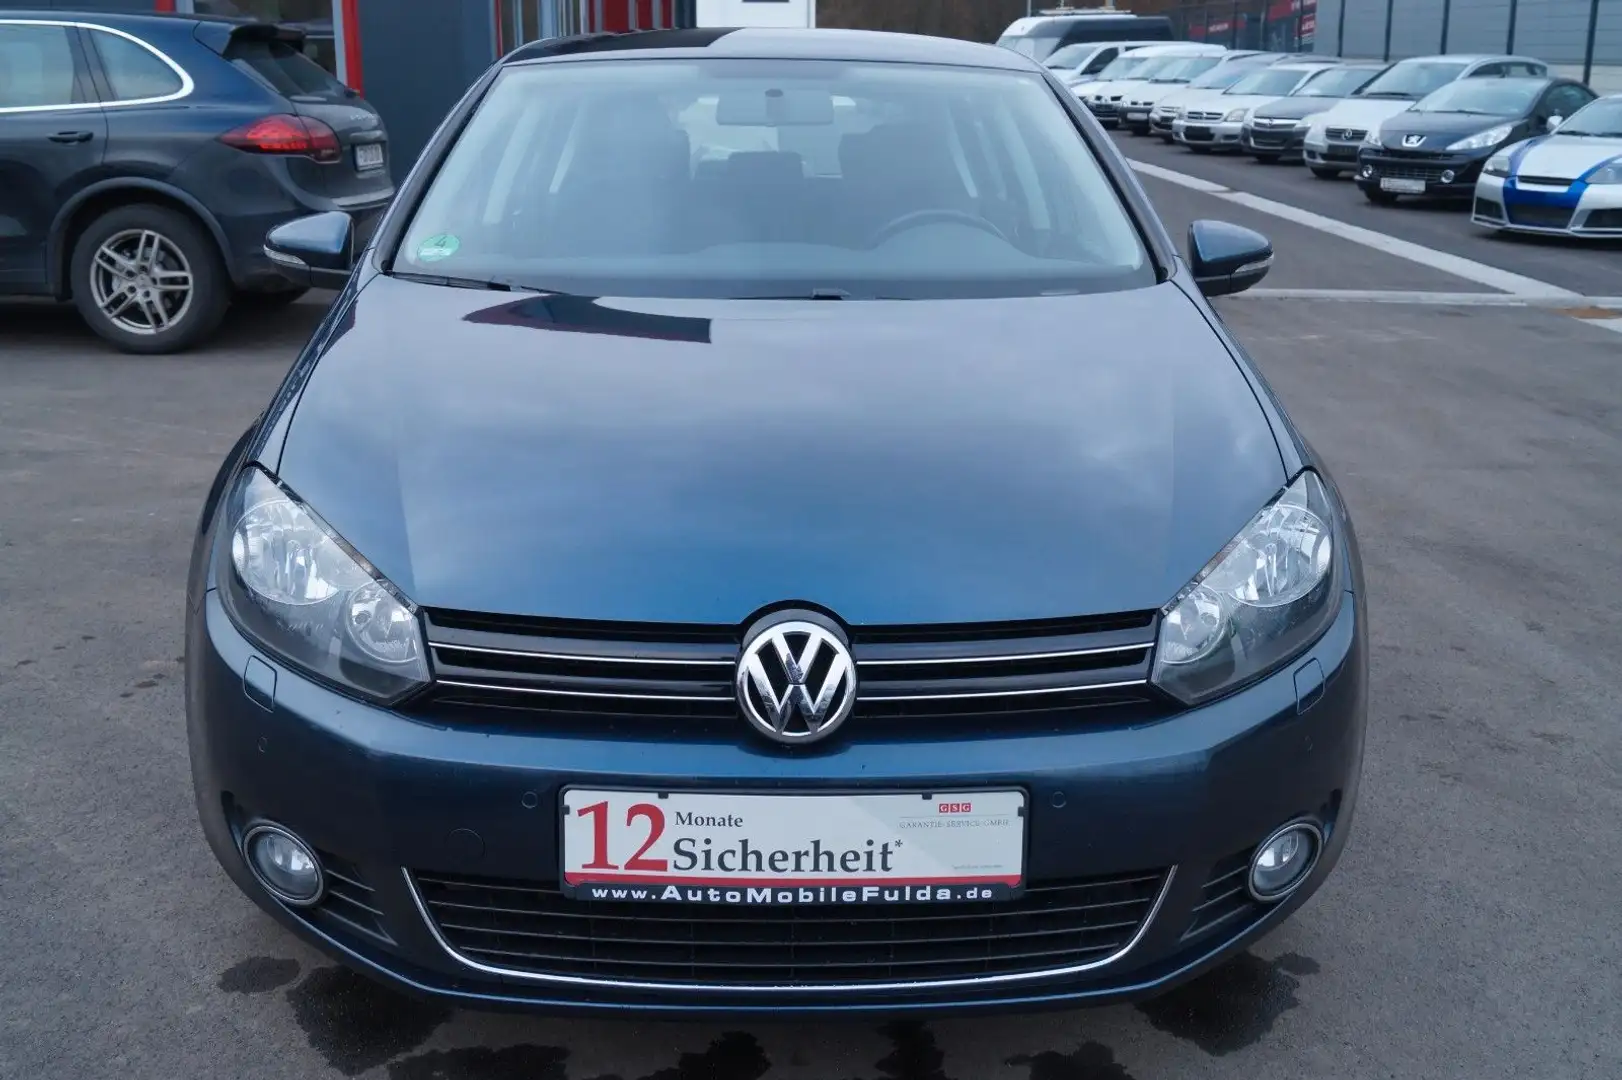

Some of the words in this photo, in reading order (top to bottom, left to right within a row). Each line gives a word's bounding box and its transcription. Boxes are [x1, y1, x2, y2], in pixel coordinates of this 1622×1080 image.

[434, 235, 447, 248] 4
[939, 804, 970, 813] GSG
[674, 811, 743, 828] Monate
[577, 801, 667, 872] 12
[592, 885, 993, 903] www.AutoMobileFulda.de
